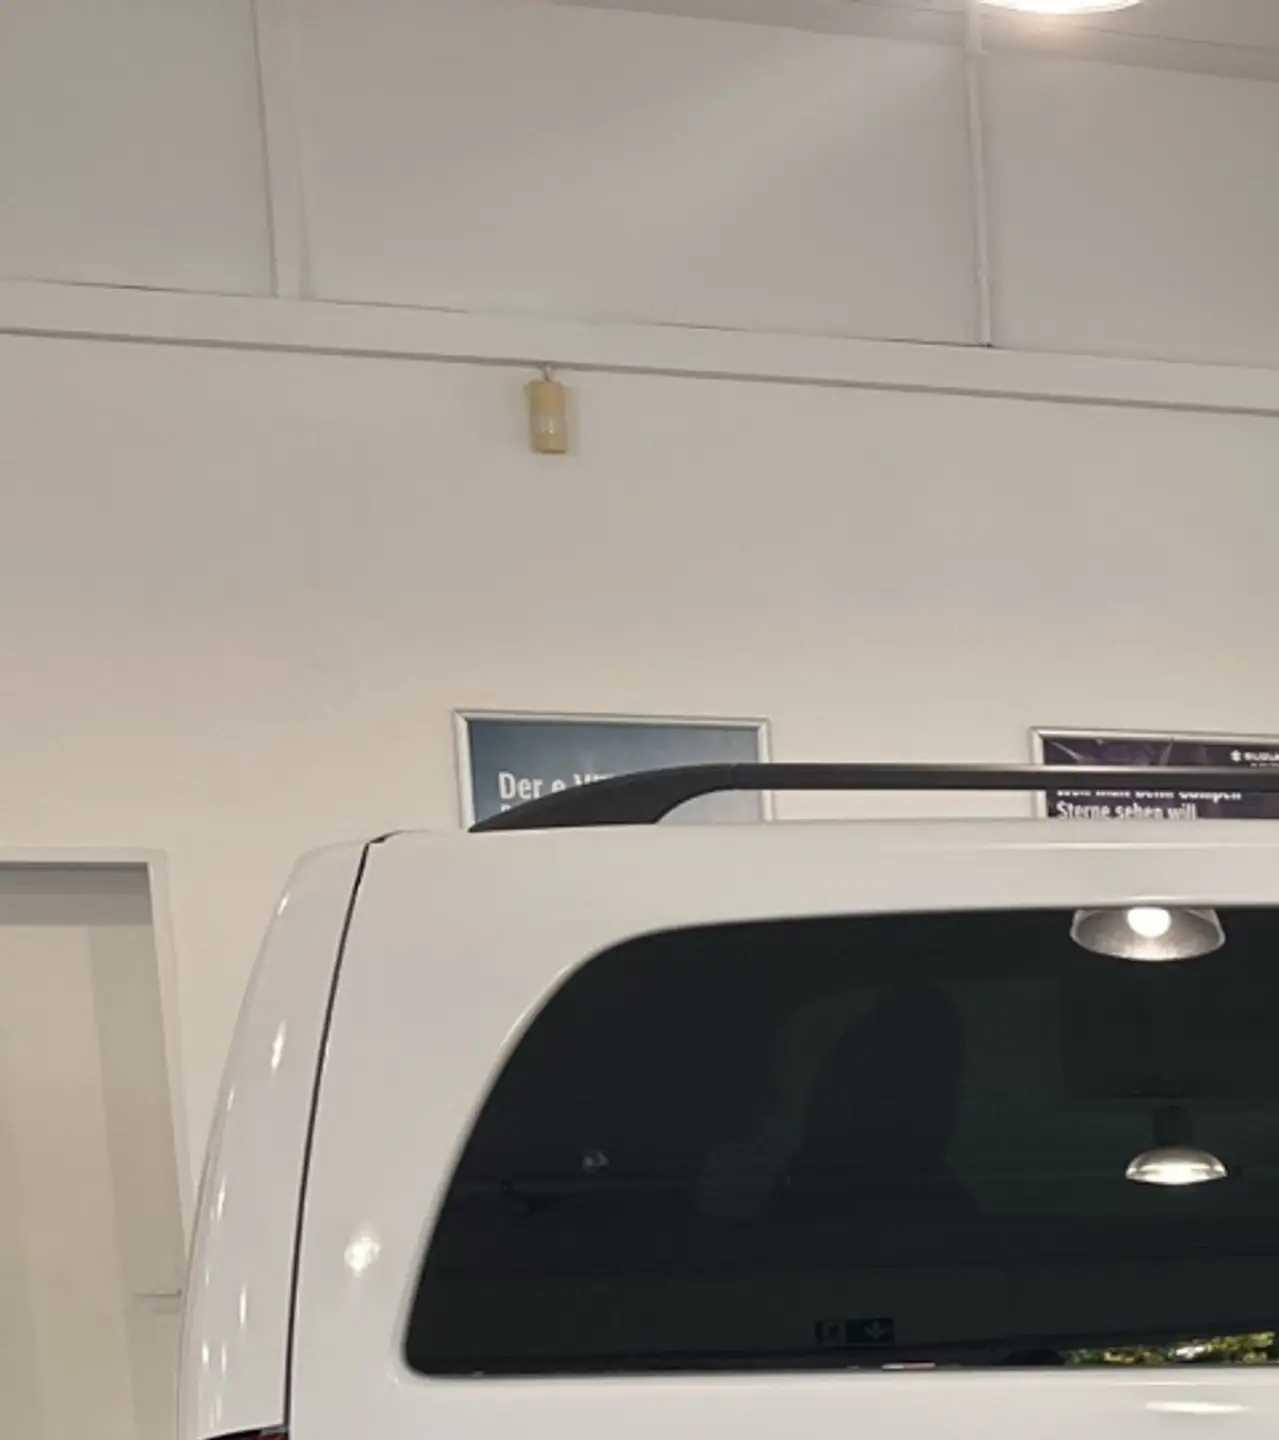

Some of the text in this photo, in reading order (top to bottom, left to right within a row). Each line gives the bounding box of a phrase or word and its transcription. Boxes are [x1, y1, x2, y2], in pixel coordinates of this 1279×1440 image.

[498, 771, 544, 799] Der
[1056, 800, 1197, 821] Sterne sehen will
